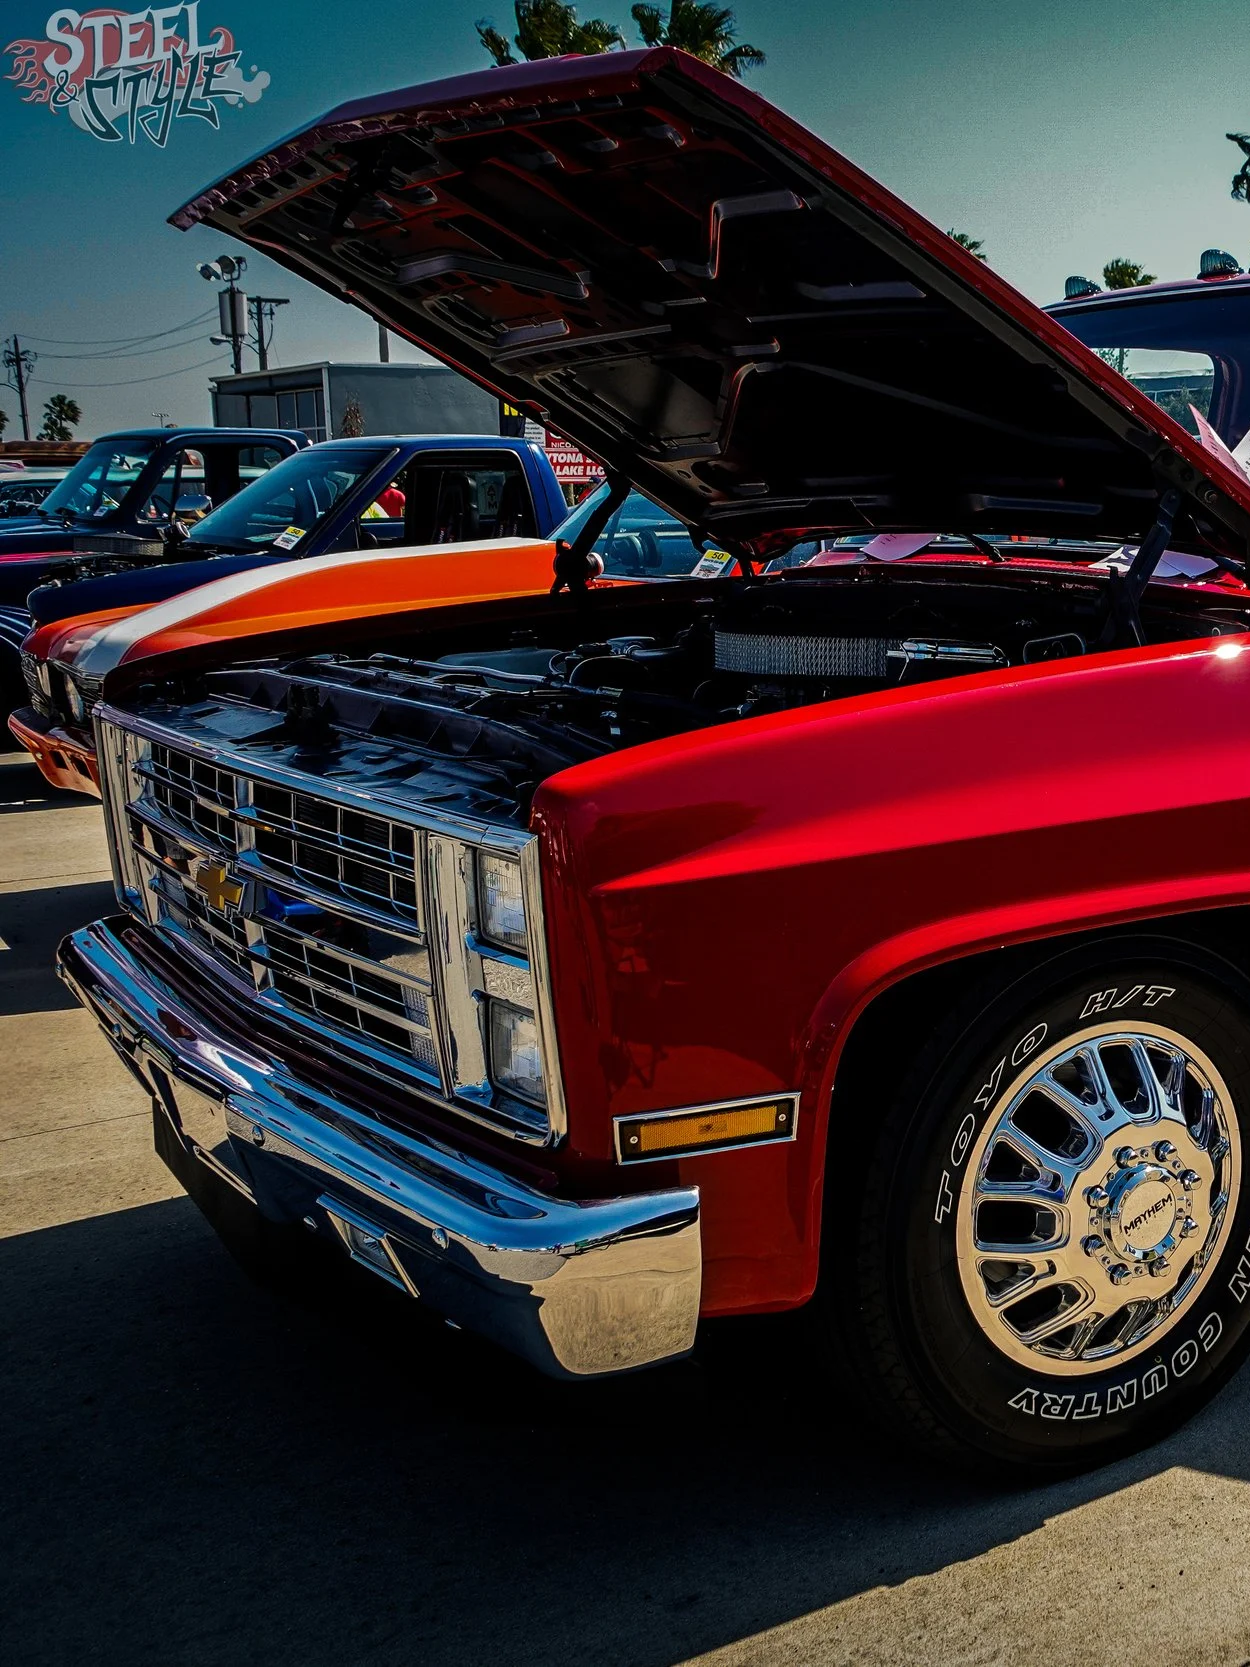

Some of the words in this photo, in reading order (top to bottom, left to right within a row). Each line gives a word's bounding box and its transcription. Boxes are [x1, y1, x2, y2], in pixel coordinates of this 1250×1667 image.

[550, 441, 576, 449] NICO
[711, 551, 724, 560] 50
[934, 1022, 1048, 1224] TOYO
[1079, 985, 1176, 1019] H/T
[1123, 1193, 1173, 1235] MAYHEM
[1008, 1312, 1223, 1420] COUNTRY
